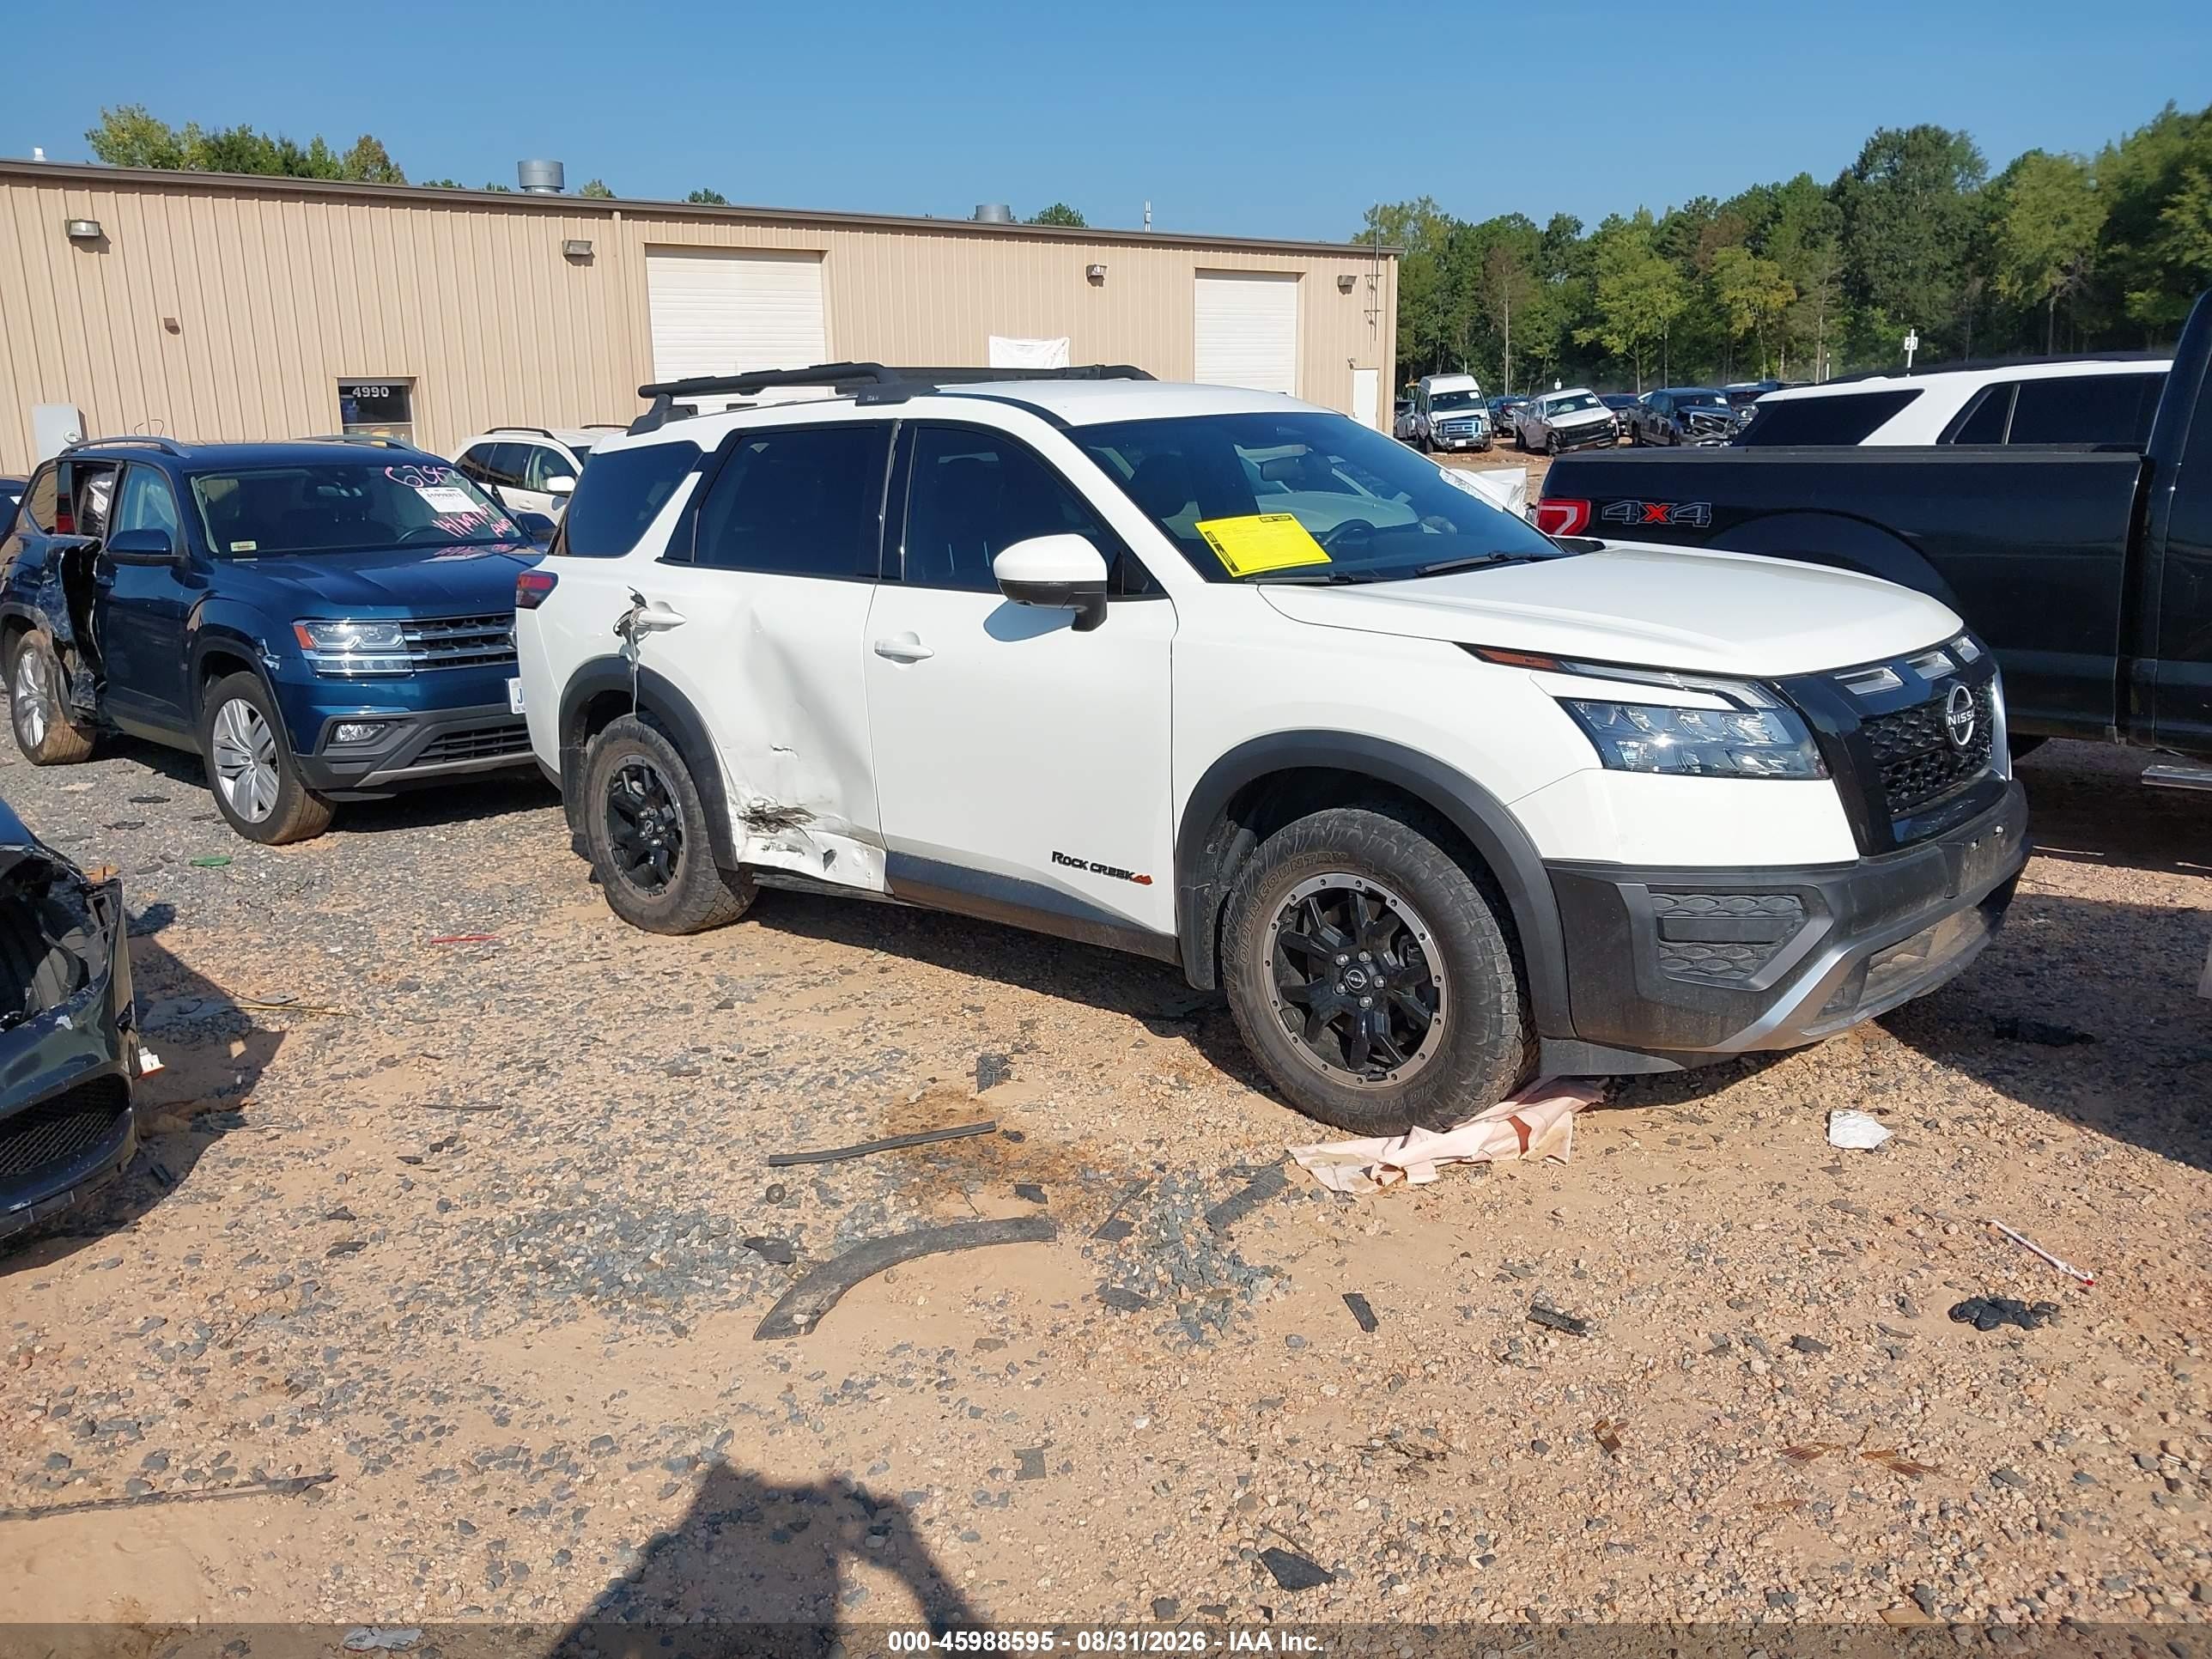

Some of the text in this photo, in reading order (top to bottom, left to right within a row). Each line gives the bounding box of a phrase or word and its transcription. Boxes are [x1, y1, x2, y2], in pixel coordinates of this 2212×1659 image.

[352, 386, 389, 398] 4990
[1601, 500, 1711, 527] 4X4
[1052, 851, 1134, 881] ROCK CREEK
[1238, 851, 1348, 964] OPEN COUNTRY
